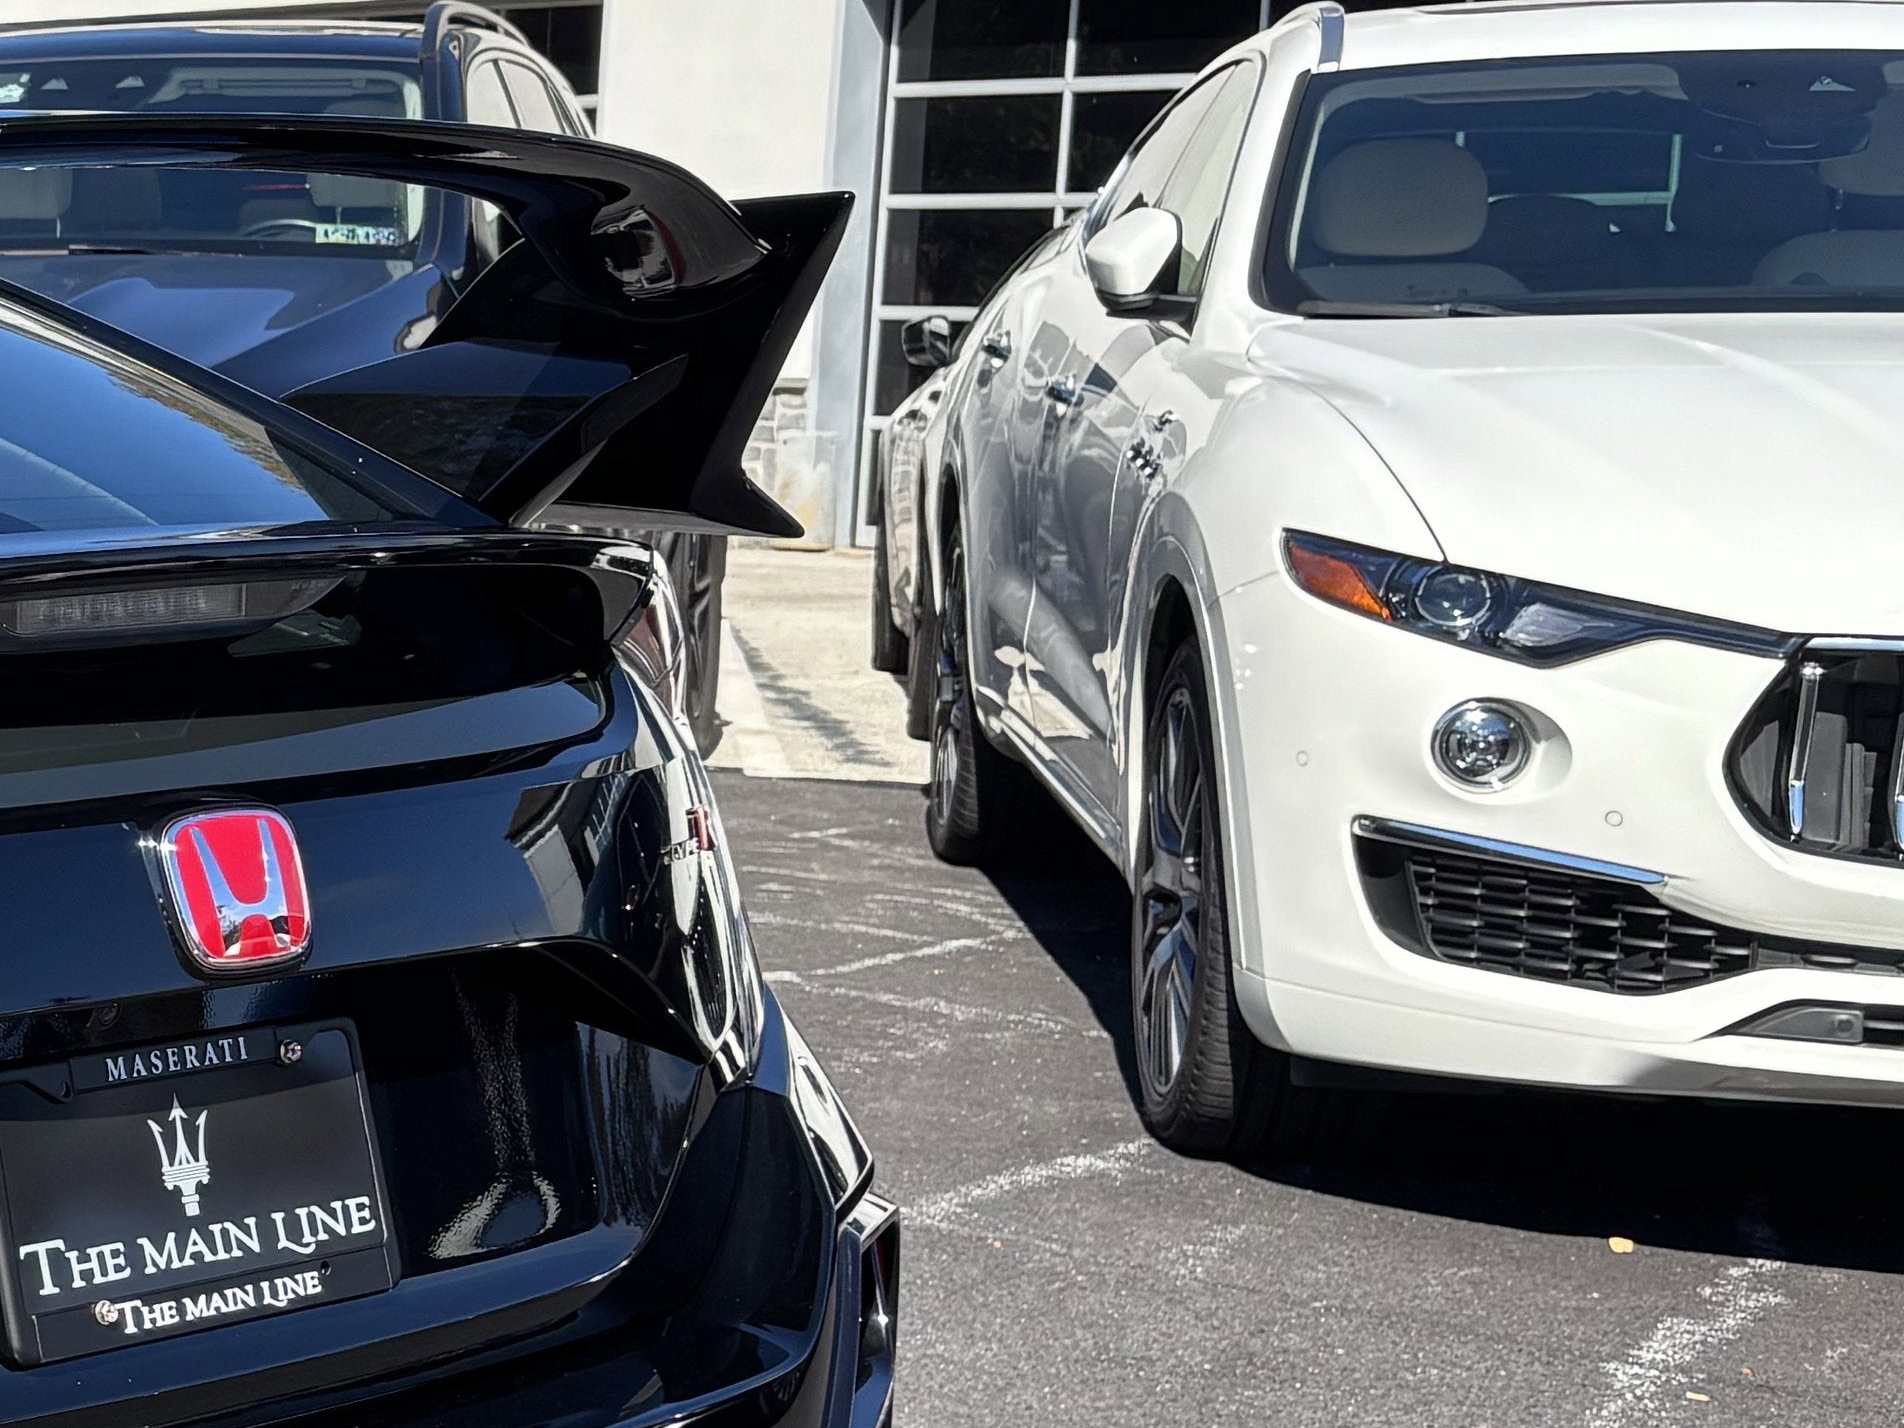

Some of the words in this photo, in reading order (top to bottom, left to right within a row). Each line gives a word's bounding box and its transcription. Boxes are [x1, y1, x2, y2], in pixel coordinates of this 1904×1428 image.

[105, 1036, 249, 1083] MASERATI
[19, 1238, 131, 1297] THE
[137, 1217, 261, 1274] MAIN
[271, 1195, 376, 1255] LINE
[116, 1299, 180, 1335] THE
[184, 1291, 255, 1320] MAIN
[260, 1270, 323, 1308] LINE
